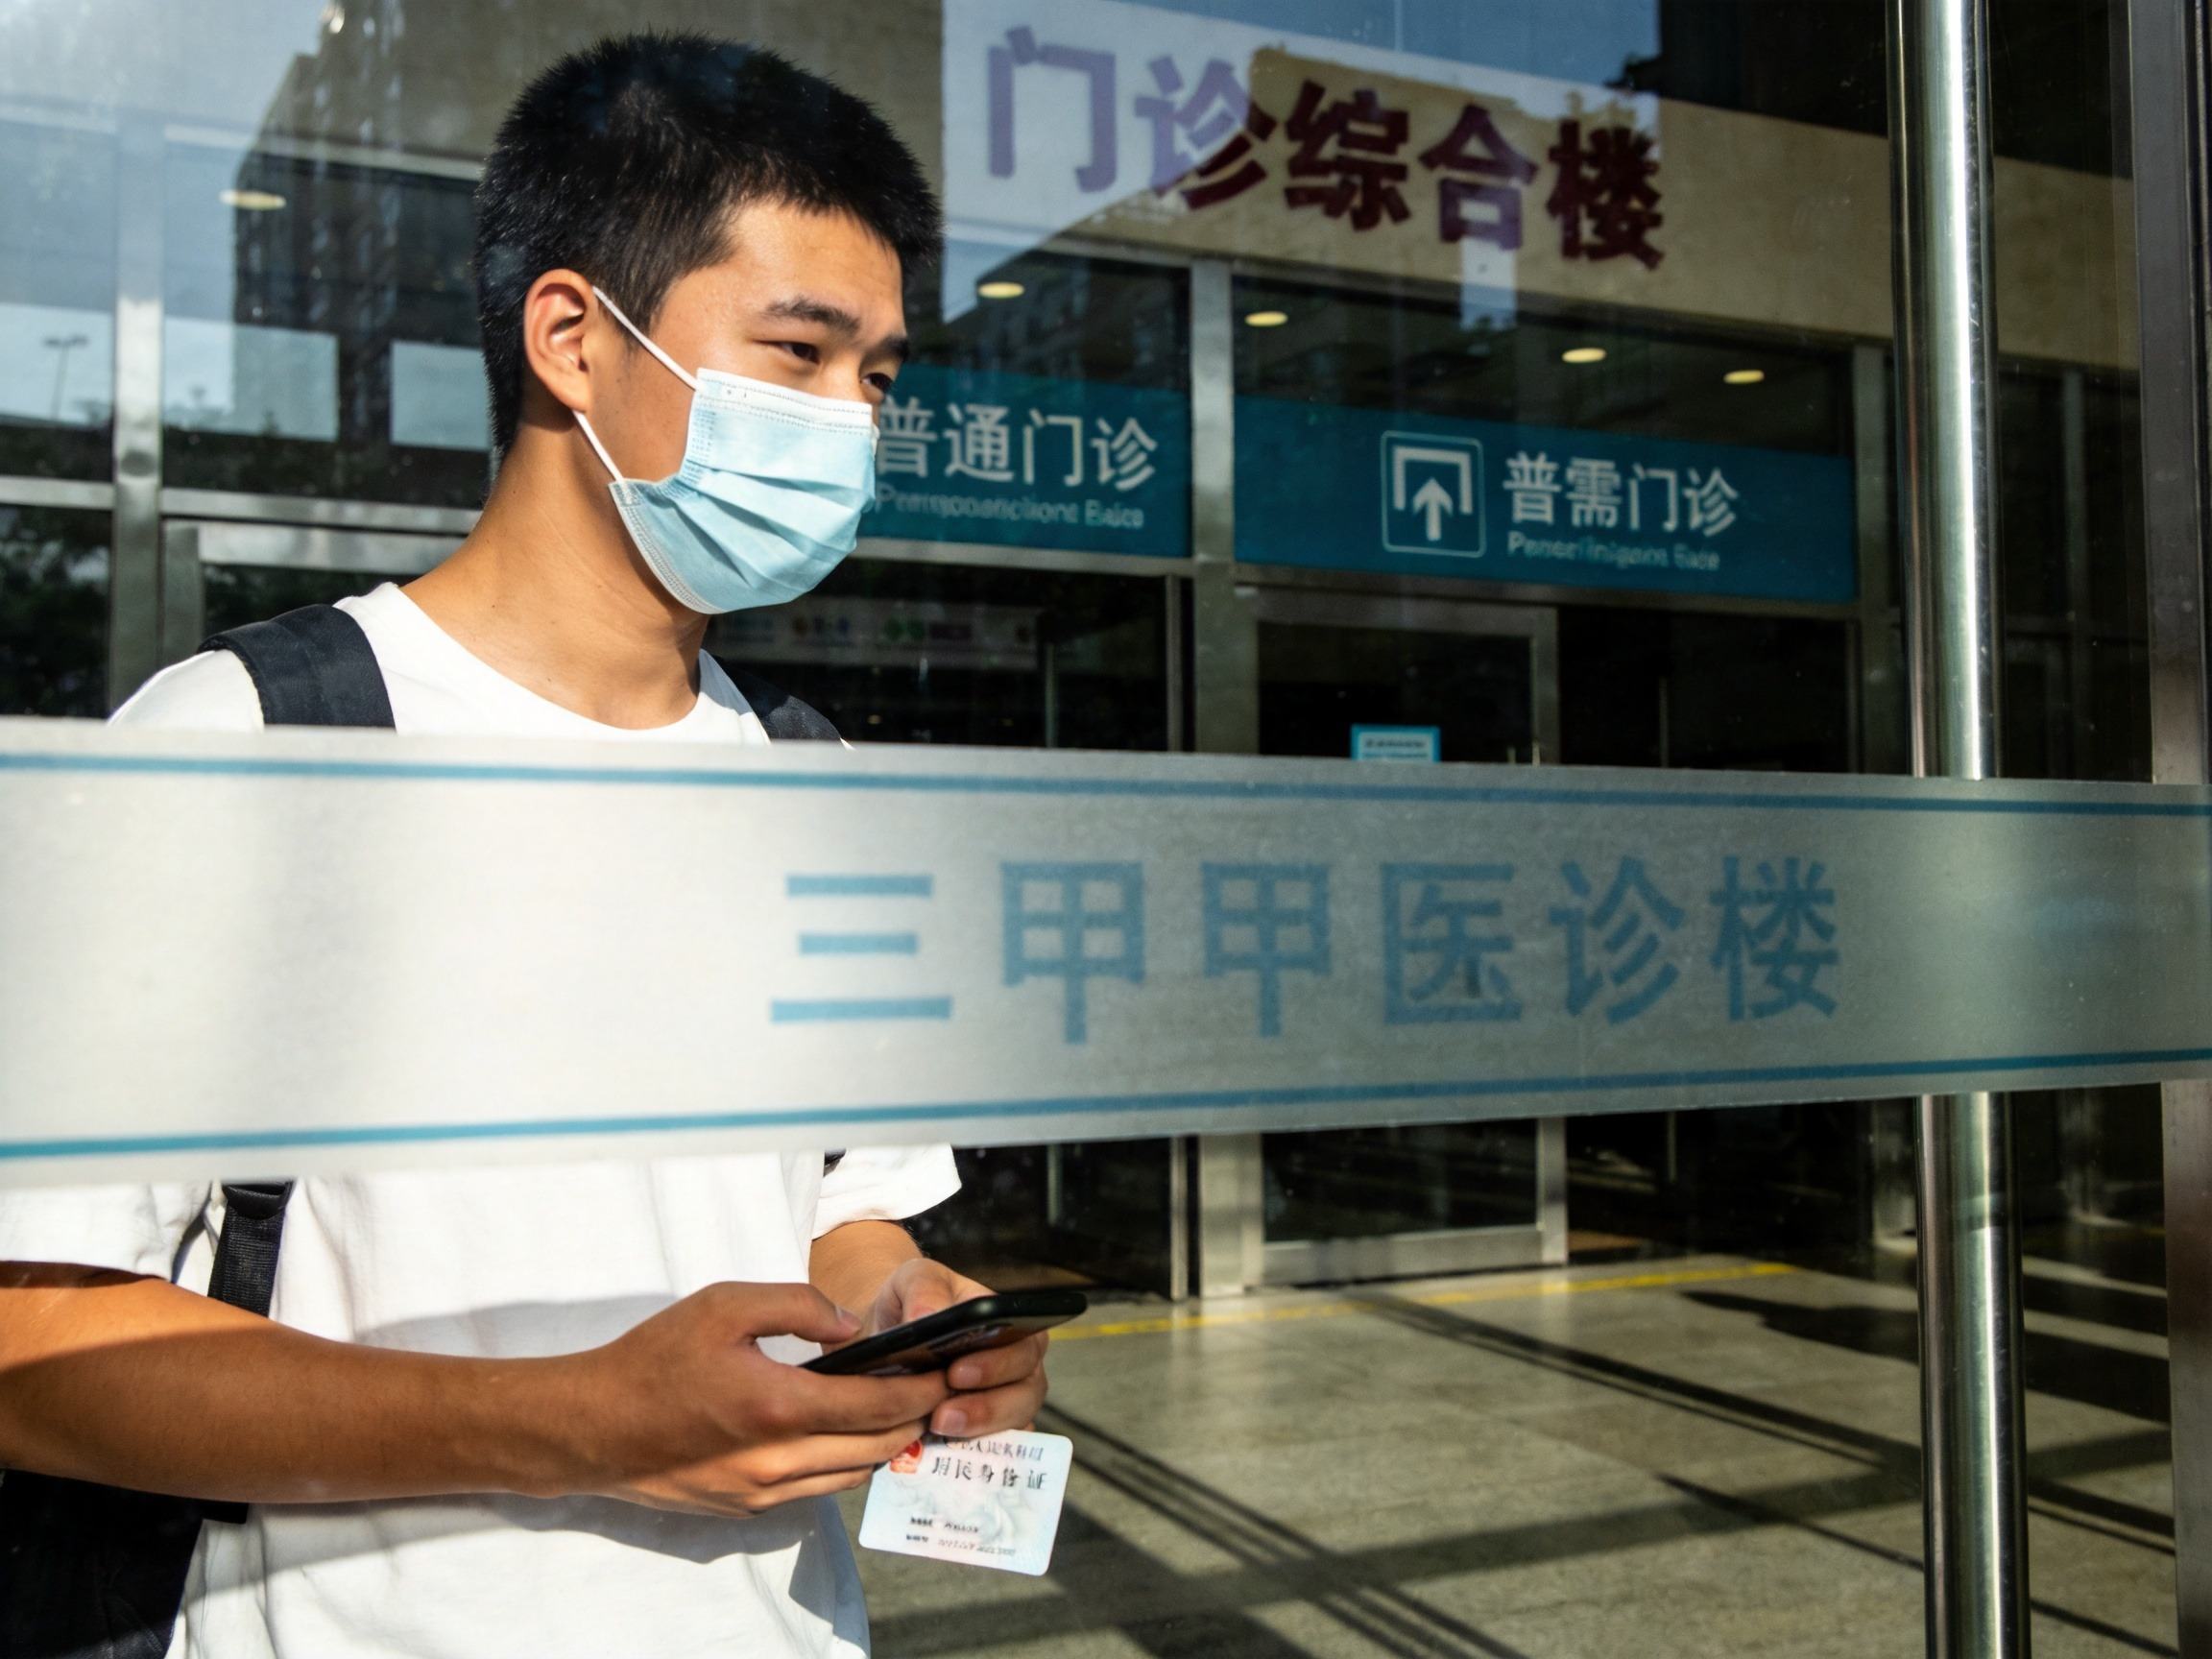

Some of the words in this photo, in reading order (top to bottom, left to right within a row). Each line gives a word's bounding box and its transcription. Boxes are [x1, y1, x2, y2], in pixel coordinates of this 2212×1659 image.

[987, 25, 1665, 271] 门诊综合楼
[876, 395, 1159, 493] 普通门诊
[1503, 450, 1740, 538] 普需门诊
[770, 854, 1840, 1046] 三甲甲医诊楼
